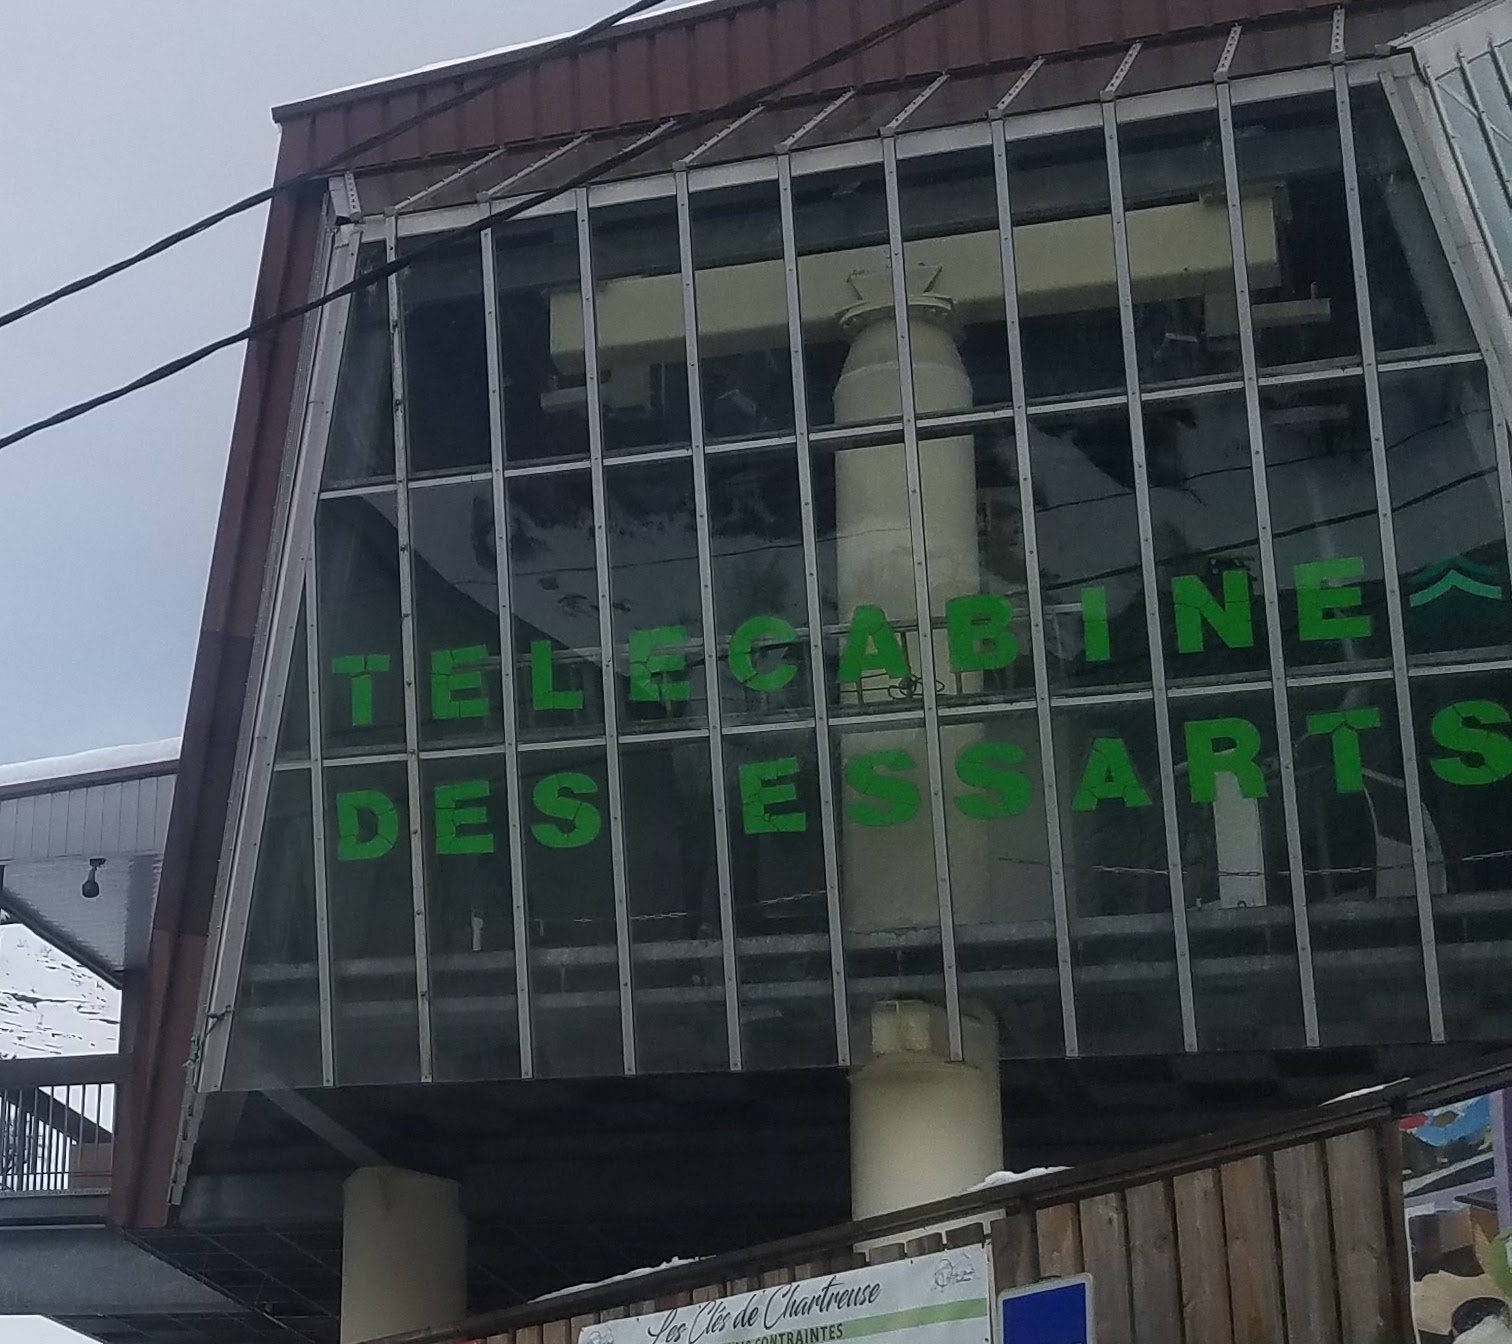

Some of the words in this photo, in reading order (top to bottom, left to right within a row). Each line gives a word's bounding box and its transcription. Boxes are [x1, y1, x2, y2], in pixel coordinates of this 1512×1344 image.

[331, 556, 1374, 728] TELECABINE
[335, 770, 603, 860] DES
[737, 698, 1512, 836] ESSARTS
[688, 1300, 731, 1344] Clés
[733, 1293, 759, 1329] de
[764, 1275, 882, 1330] Chartreuse
